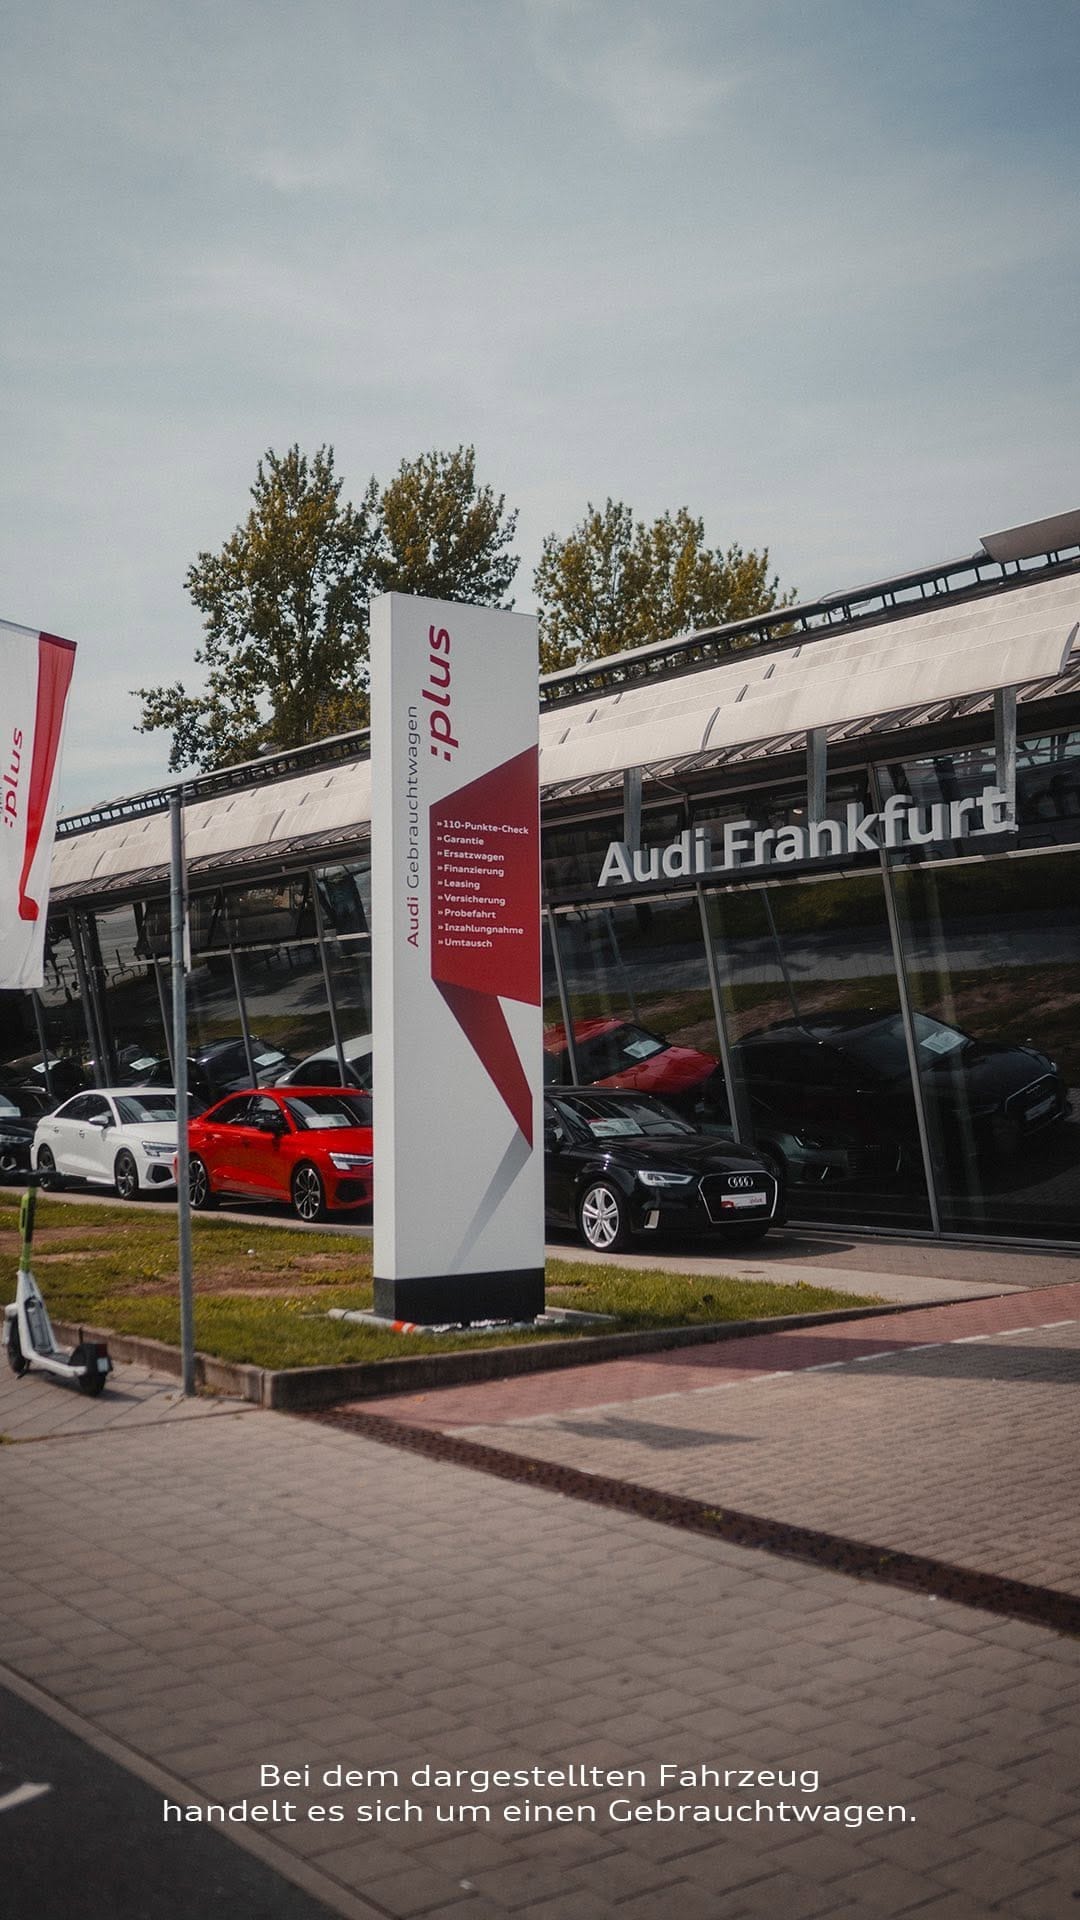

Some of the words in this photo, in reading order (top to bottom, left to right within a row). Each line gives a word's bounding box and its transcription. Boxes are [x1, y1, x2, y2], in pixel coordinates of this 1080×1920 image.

[406, 706, 421, 889] Gebrauchtwagen
[443, 820, 529, 834] 110-Punkte-Check
[443, 834, 484, 845] Garantie
[597, 828, 706, 887] Audi
[724, 785, 1019, 870] Frankfurt
[443, 849, 505, 862] Ersatzwagen
[443, 864, 505, 877] Finanzierung
[444, 879, 480, 891] Leasing
[444, 894, 506, 906] Versicherung
[444, 908, 497, 919] Probefahrt
[407, 896, 420, 948] Audi
[444, 923, 524, 935] Inzahlungnahme
[444, 938, 493, 948] Umtausch
